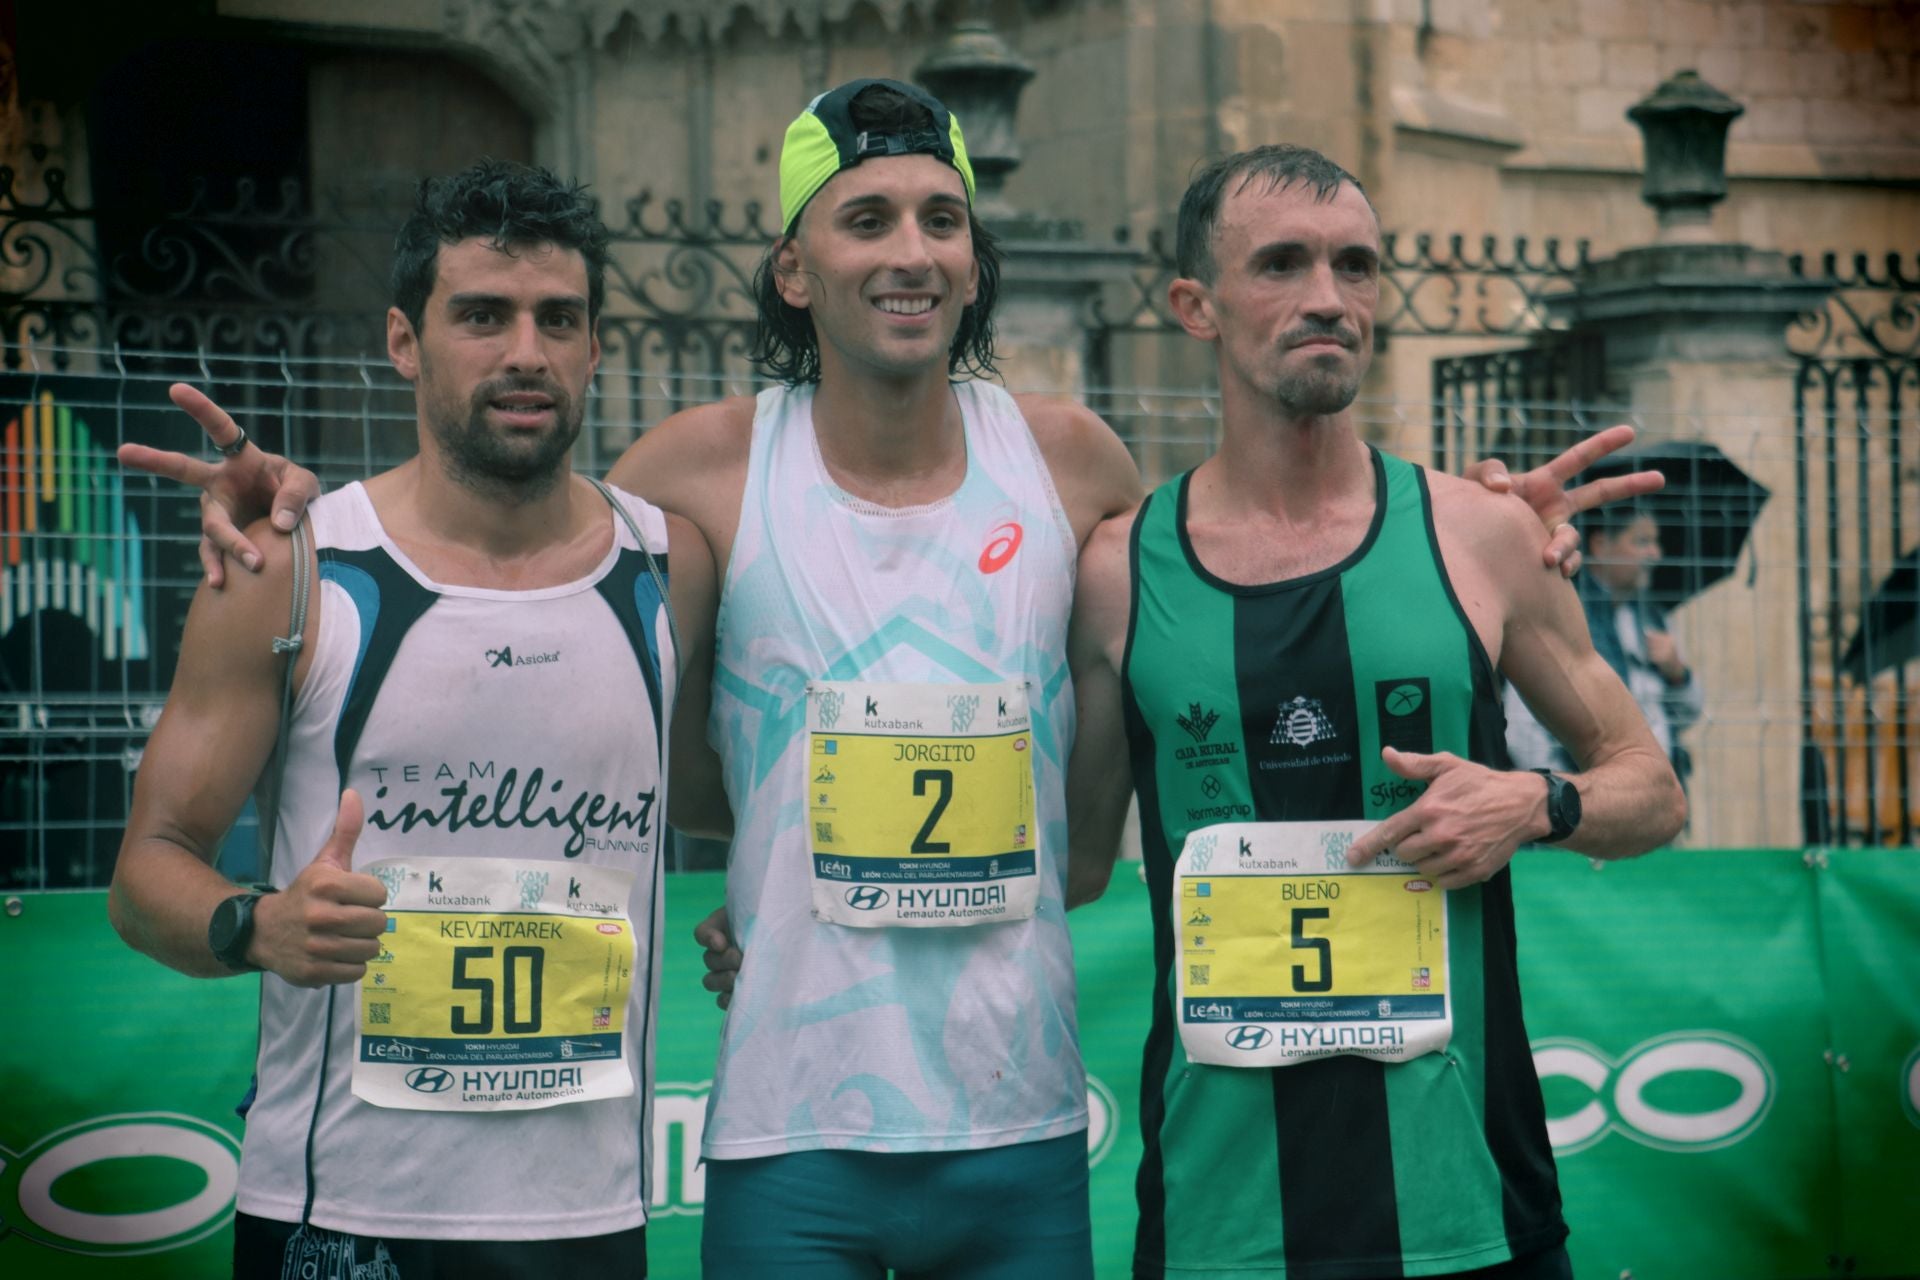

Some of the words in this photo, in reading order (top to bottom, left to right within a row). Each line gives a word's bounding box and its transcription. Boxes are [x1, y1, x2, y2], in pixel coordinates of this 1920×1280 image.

[515, 651, 559, 667] Asioka
[864, 718, 923, 730] kutxabank
[894, 744, 976, 762] JORGITO
[1199, 742, 1240, 757] RURAL
[1259, 755, 1309, 771] Universidad
[1311, 755, 1320, 768] de
[1322, 752, 1352, 765] Oviedo
[370, 760, 495, 783] TEAM
[367, 767, 656, 858] intelligent
[910, 769, 954, 854] 2
[1186, 804, 1252, 821] Normagrup
[584, 837, 649, 853] RUNNING
[898, 862, 919, 870] 10KM
[919, 862, 951, 870] HYUNDAI
[1239, 858, 1298, 869] kutxabank
[861, 869, 881, 879] LEÓN
[882, 870, 902, 879] CUNA
[904, 871, 917, 879] DEL
[918, 870, 984, 879] PARLAMENTARISMO
[897, 884, 1006, 908] HYUNDAI
[1282, 880, 1340, 900] BUEÑO
[428, 895, 491, 906] kutxabank
[897, 907, 946, 919] Lemauto
[949, 906, 1006, 918] Automoción
[440, 919, 563, 940] KEVINTAREK
[1291, 907, 1333, 993] 5
[450, 945, 545, 1034] 50
[1280, 1001, 1300, 1009] 10KM
[1301, 1001, 1334, 1009] HYUNDAI
[1244, 1009, 1264, 1018] LEÓN
[1301, 1009, 1370, 1018] PARLAMENTARISMO
[1280, 1026, 1404, 1046] HYUNDAI
[464, 1042, 485, 1051] 10KM
[486, 1042, 520, 1050] HYUNDAI
[1281, 1047, 1330, 1057] Lemauto
[1334, 1045, 1404, 1056] Automoción
[426, 1051, 447, 1061] LEÓN
[447, 1052, 469, 1061] CUNA
[470, 1053, 484, 1061] DEL
[486, 1051, 553, 1061] PARLAMENTARISMO
[463, 1067, 582, 1092] HYUNDAI
[462, 1092, 513, 1102] Lemauto
[515, 1087, 584, 1101] Automoción
